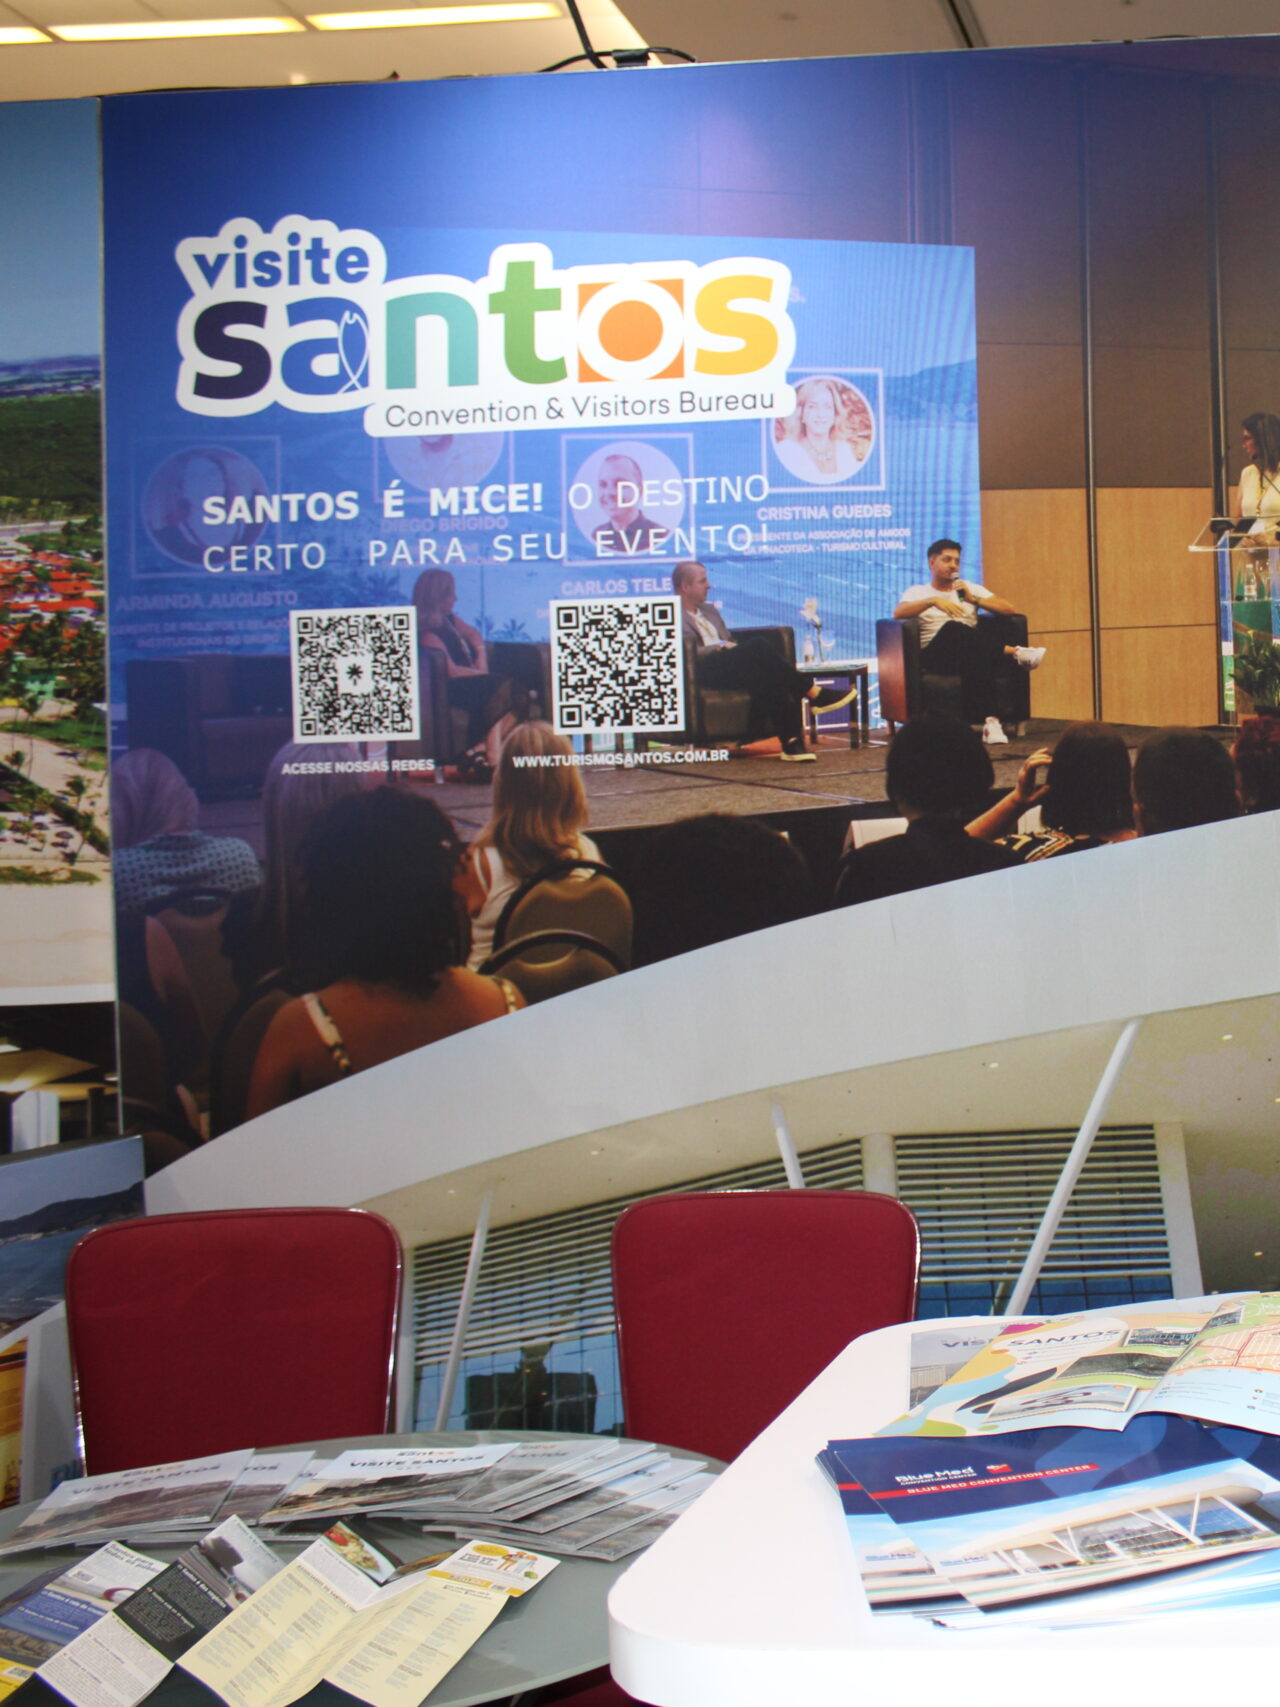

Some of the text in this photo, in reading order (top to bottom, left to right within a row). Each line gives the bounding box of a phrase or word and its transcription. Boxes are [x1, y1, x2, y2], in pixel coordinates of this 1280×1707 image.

[193, 231, 370, 291] visite
[193, 261, 779, 399] santos
[385, 391, 774, 427] Convention & Visitors Bureau
[203, 474, 769, 525] SANTOS É MICE! O DESTINO
[757, 504, 892, 520] CRISTINA GUEDES
[203, 542, 326, 573] CERTO
[369, 536, 467, 567] PARA
[492, 532, 567, 561] SEU
[596, 523, 768, 557] EVENTO!
[560, 579, 628, 595] CARLOS
[116, 590, 298, 611] ARMINDA AUGUSTO
[282, 759, 435, 775] ACESSE NOSSAS REDES
[512, 750, 729, 768] WWW.TURISMOSANTOS.COM.BR
[1008, 1328, 1121, 1346] SANTOS
[350, 1455, 485, 1467] VISITE SANTOS
[72, 1464, 221, 1495] VISITE SANTOS
[894, 1466, 974, 1483] Blue Med
[906, 1464, 1091, 1494] BLUE MED CONVENTION CENTER
